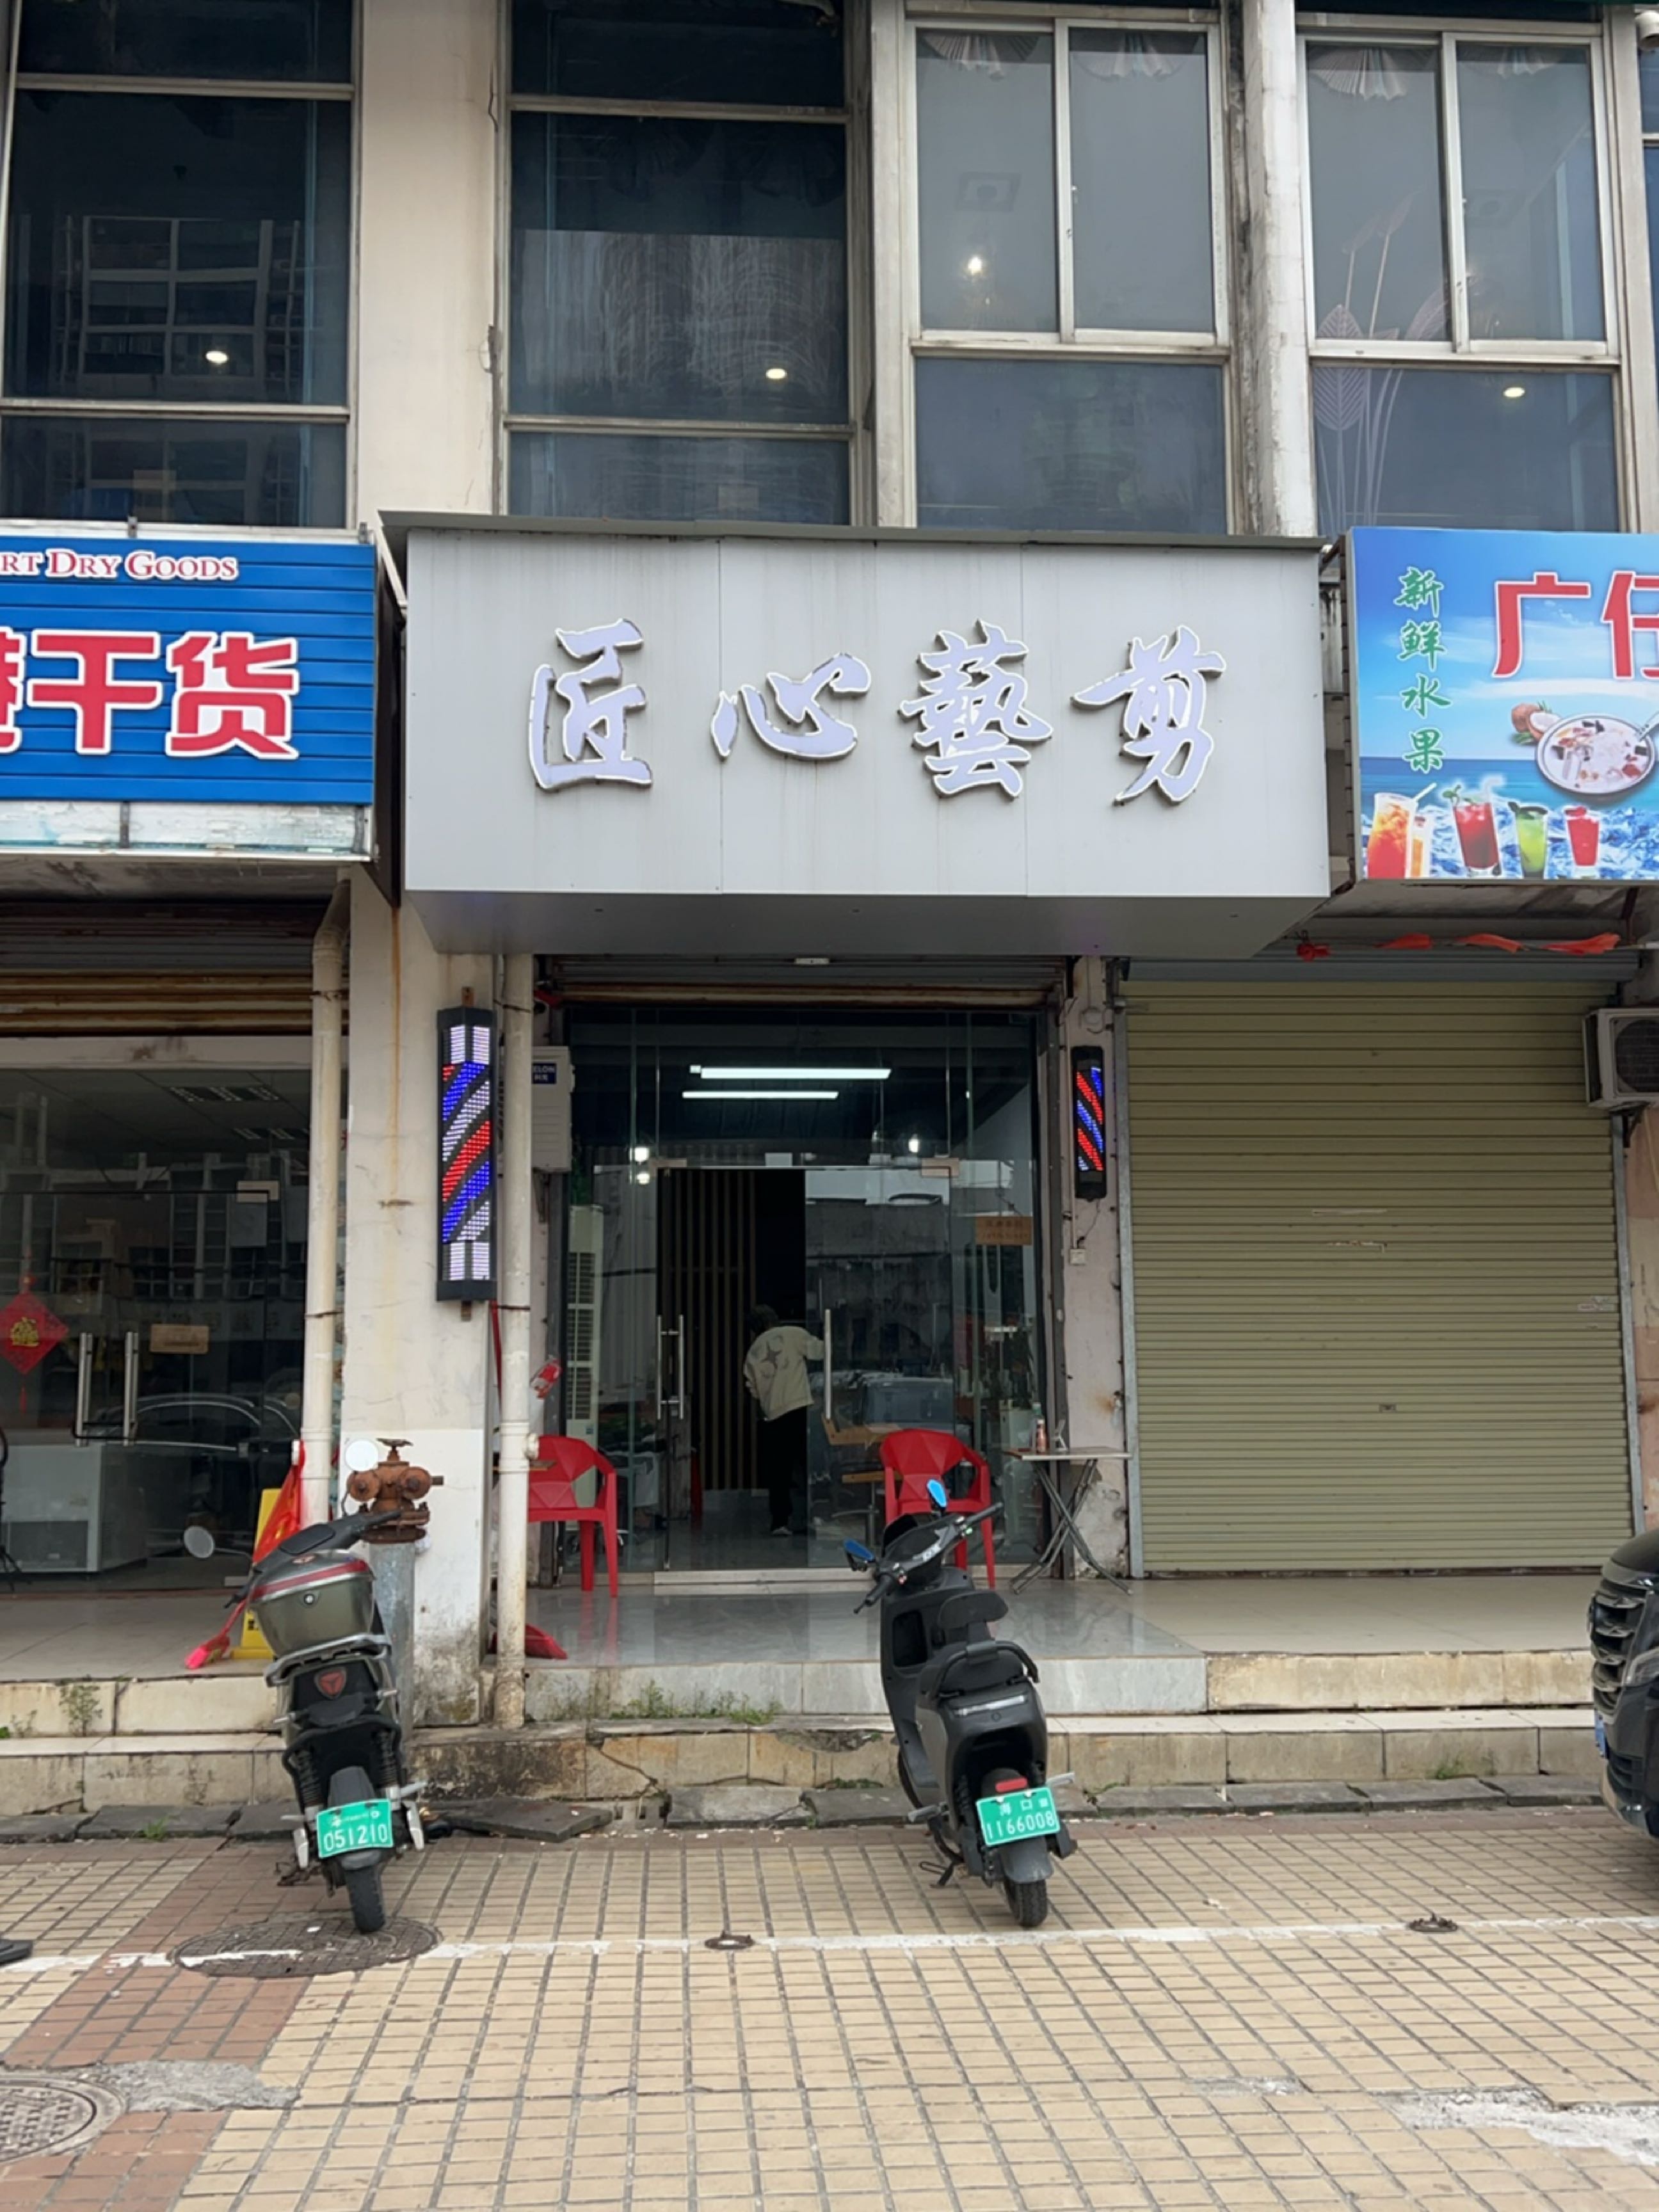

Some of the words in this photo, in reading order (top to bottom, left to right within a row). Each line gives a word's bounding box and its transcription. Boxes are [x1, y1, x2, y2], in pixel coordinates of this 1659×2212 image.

[47, 549, 121, 577] DRY
[125, 550, 238, 579] GOODS
[0, 627, 298, 758] 干货
[324, 1824, 388, 1851] 051210
[986, 1811, 1055, 1839] 1166008
